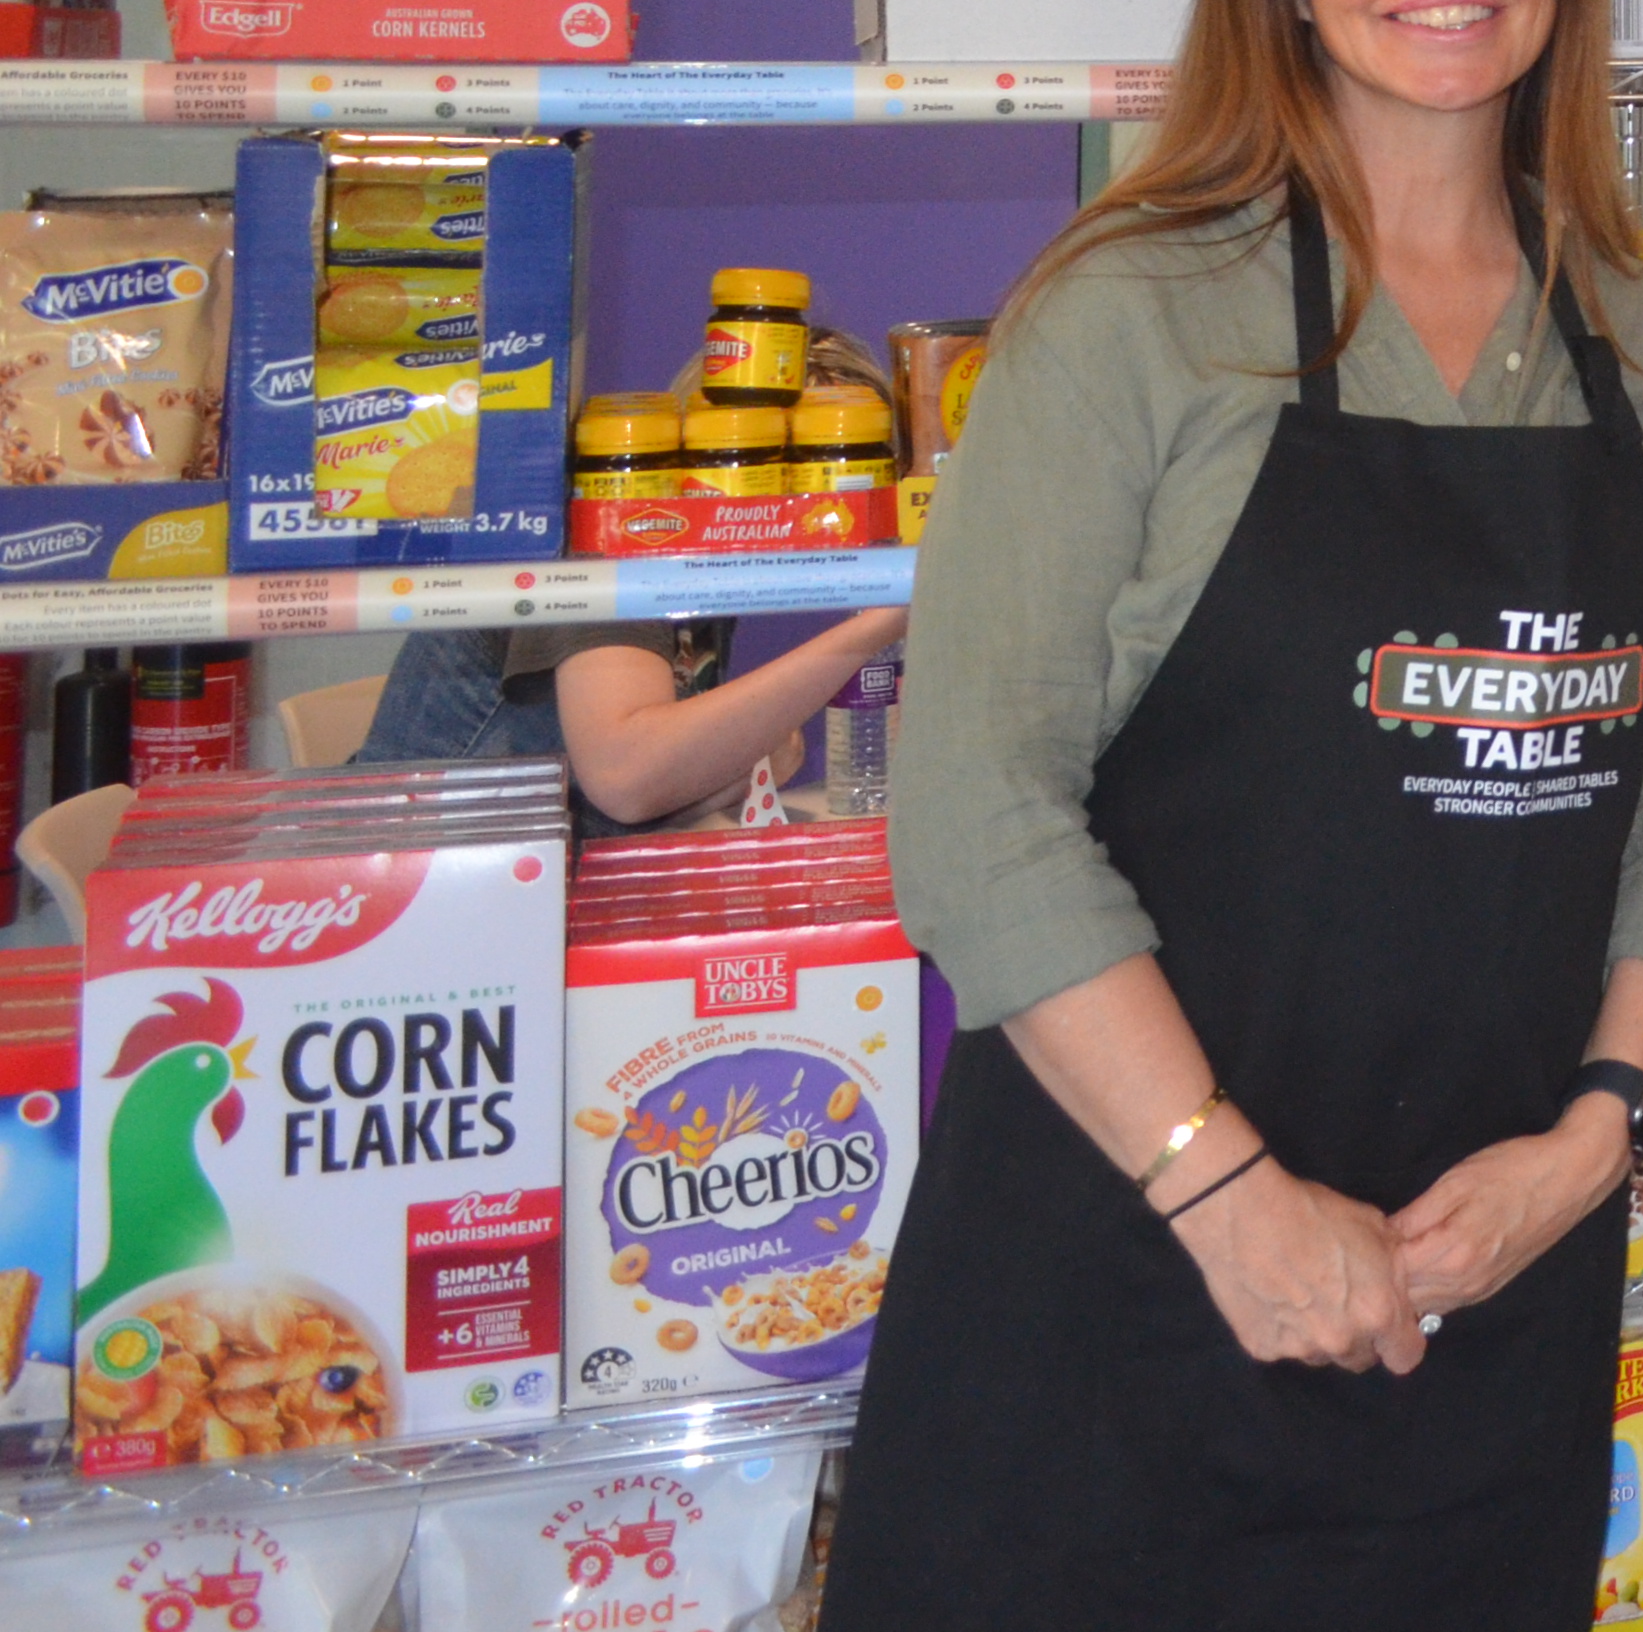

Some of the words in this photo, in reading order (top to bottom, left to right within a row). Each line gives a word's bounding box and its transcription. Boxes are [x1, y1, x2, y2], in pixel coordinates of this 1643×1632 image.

[209, 6, 282, 28] Edgell
[385, 7, 437, 19] AUSTRALIAN
[440, 9, 473, 19] GROWN
[372, 21, 414, 38] CORN
[419, 21, 485, 39] KERNELS
[316, 435, 391, 469] Marie
[475, 512, 513, 532] 3.7
[518, 512, 548, 535] kg
[715, 505, 781, 525] PROUDLY
[144, 519, 205, 550] Bites
[702, 524, 794, 542] AUSTRALIAN
[257, 592, 297, 604] GIVES
[300, 591, 329, 602] YOU
[259, 579, 301, 590] EVERY
[258, 609, 274, 619] 10
[278, 606, 328, 618] POINTS
[260, 622, 278, 631] TO
[281, 620, 327, 630] SPEND
[1499, 610, 1584, 652] THE
[1402, 662, 1628, 713] EVERYDAY
[1456, 726, 1584, 770] TABLE
[1404, 776, 1472, 795] EVERYDAY
[1536, 777, 1577, 794] SHARED
[1578, 771, 1618, 788] TABLES
[1434, 798, 1513, 815] STRONGER
[1516, 792, 1592, 816] COMMUNITIES
[127, 880, 366, 953] Kellogg's
[704, 957, 786, 983] UNCLE
[294, 1003, 329, 1013] THE
[341, 993, 437, 1010] ORIGINAL
[470, 985, 518, 999] BEST
[282, 1004, 516, 1103] CORN
[605, 1037, 674, 1093] FIBRE
[677, 1023, 724, 1047] FROM
[632, 1051, 688, 1089] WHOLE
[693, 1031, 758, 1054] GRAINS
[285, 1090, 517, 1177] FLAKES
[617, 1134, 876, 1228] Cheerios
[448, 1190, 522, 1226] Real
[415, 1217, 553, 1247] NOURISHMENT
[671, 1237, 792, 1275] ORIGINAL
[437, 1263, 512, 1287] SIMPLY
[513, 1256, 530, 1276] 4
[437, 1276, 530, 1299] INGREDIENTS
[438, 1322, 473, 1346] +6
[642, 1376, 678, 1395] 320g
[114, 1438, 157, 1460] 380g
[539, 1496, 586, 1541] RED
[593, 1476, 704, 1525] TRACTOR
